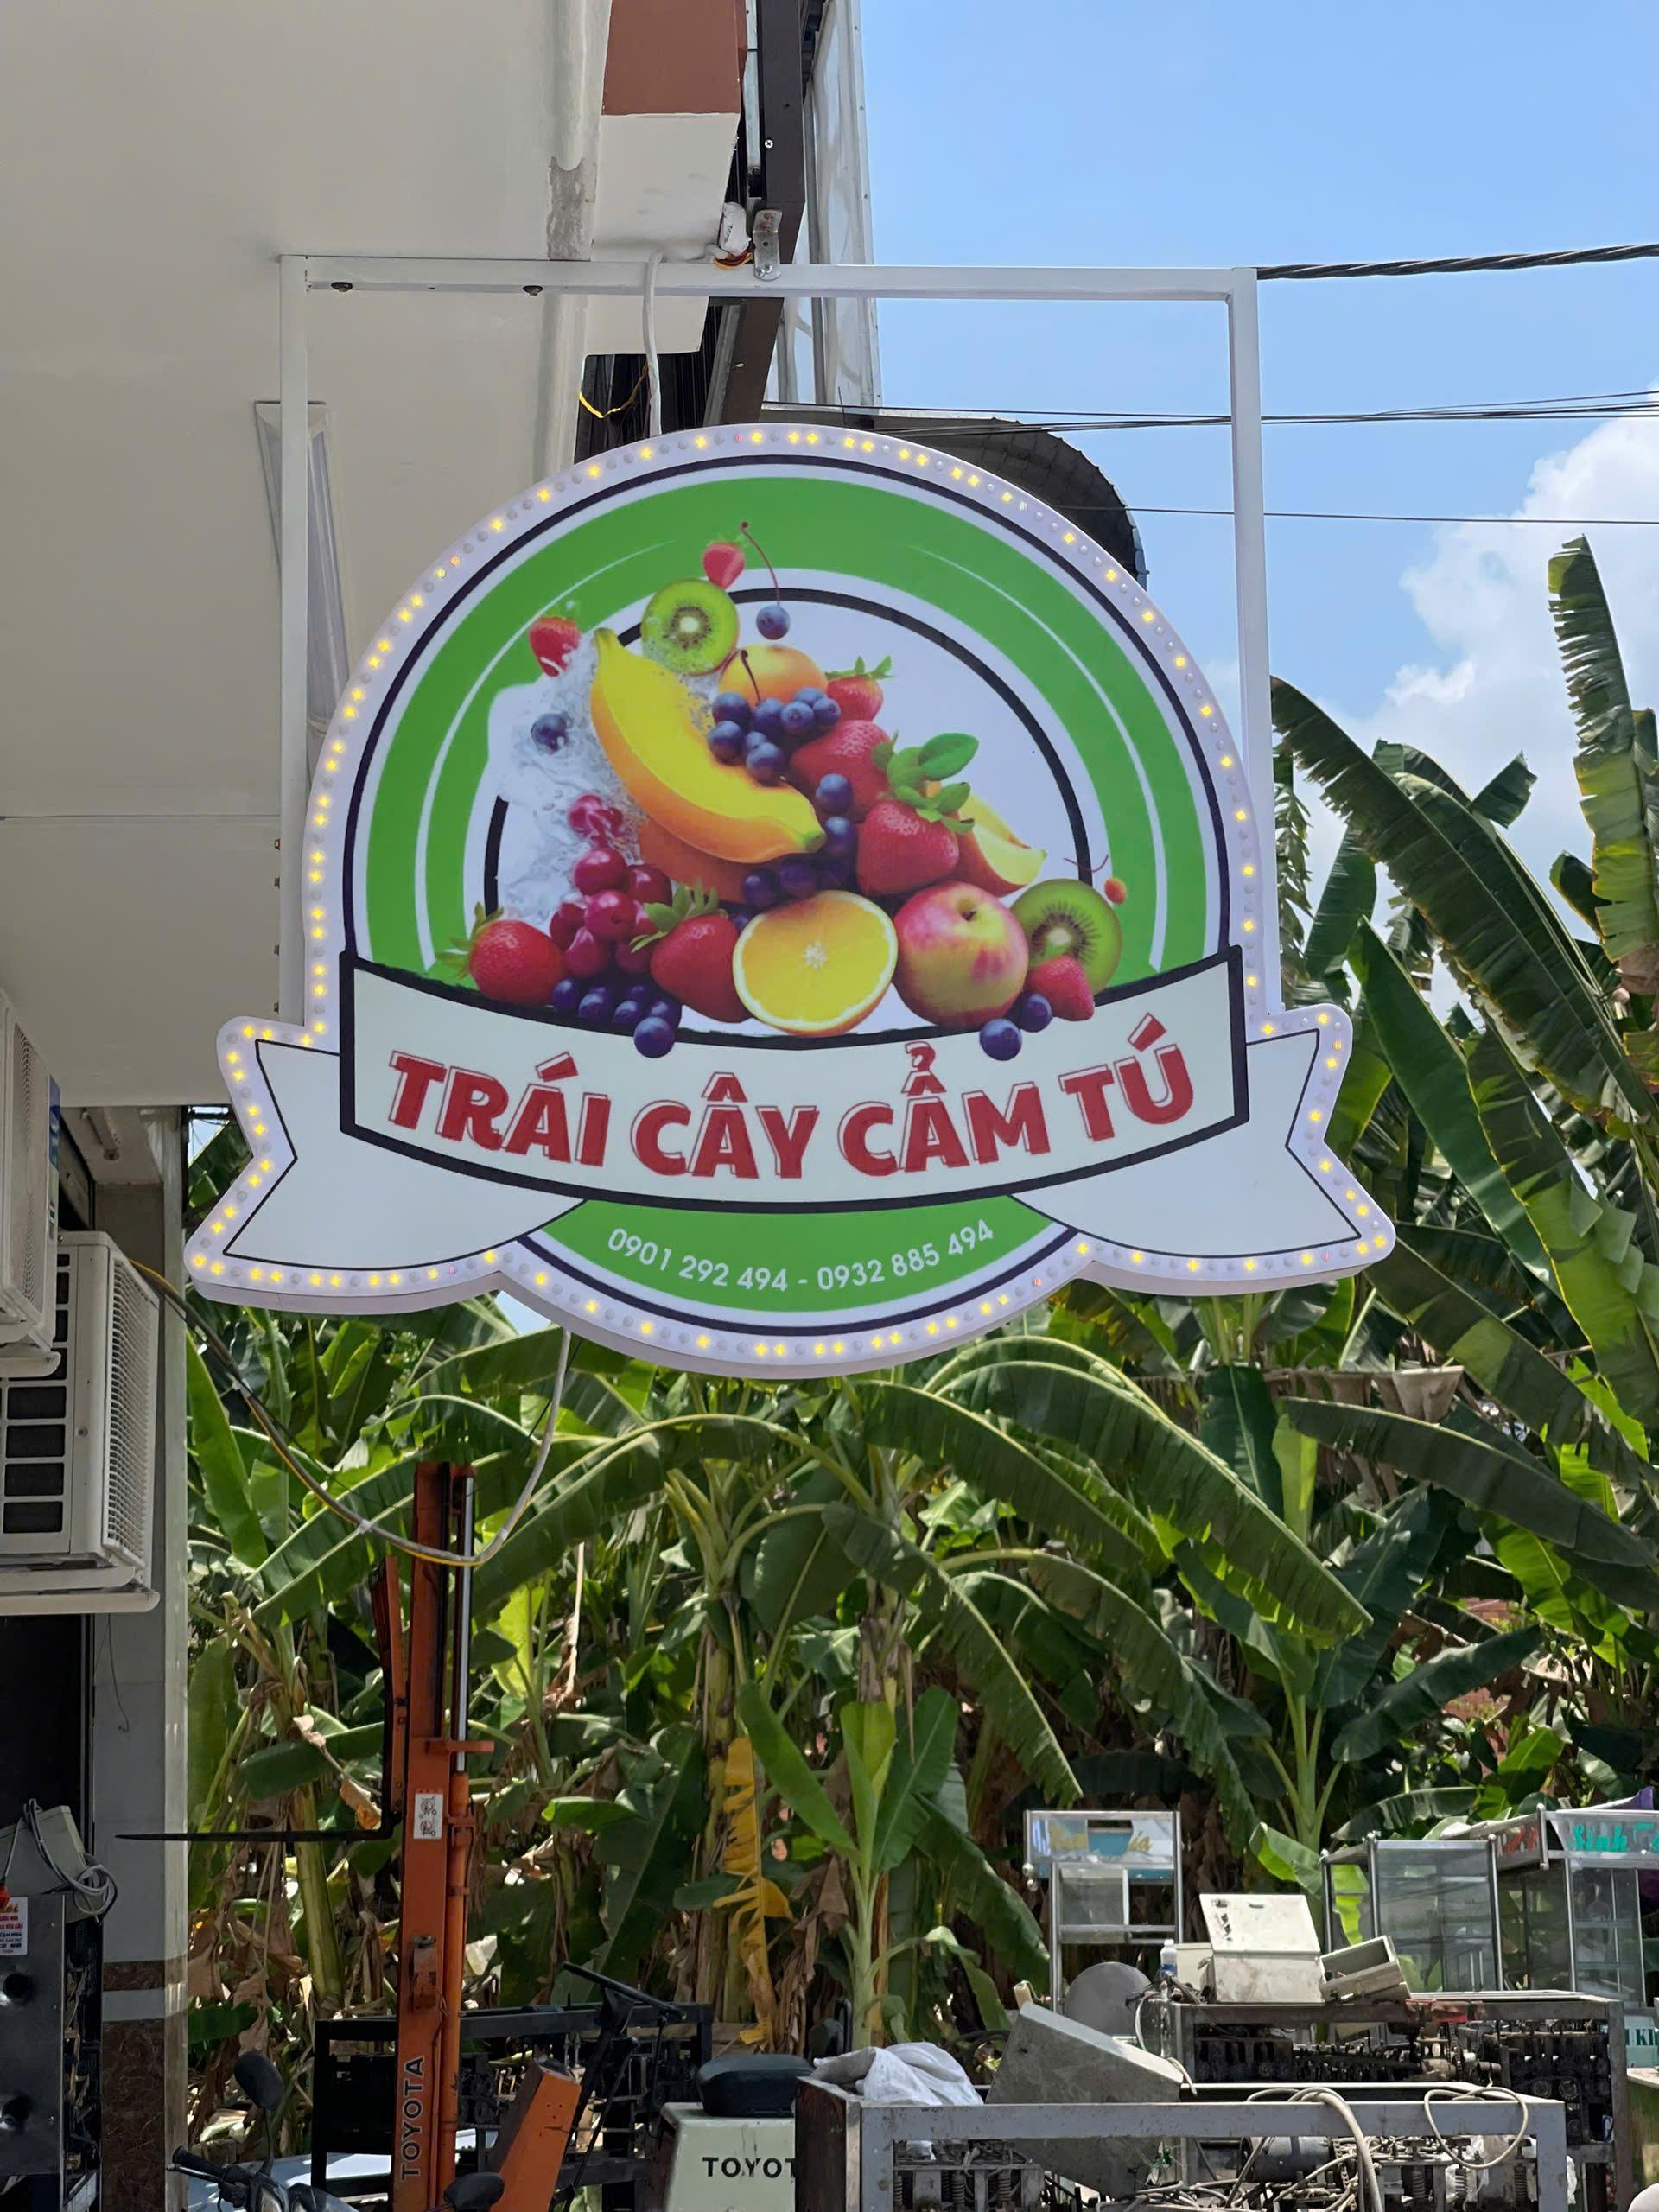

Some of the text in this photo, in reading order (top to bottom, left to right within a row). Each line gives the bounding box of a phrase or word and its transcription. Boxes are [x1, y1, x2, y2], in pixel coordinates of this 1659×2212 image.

[388, 1012, 1193, 1179] TRÁI CÂY CẨM TÚ
[608, 1228, 671, 1271] 0901
[678, 1255, 729, 1287] 292
[736, 1267, 788, 1292] 494
[817, 1259, 885, 1291] 0932
[891, 1243, 940, 1276] 885
[948, 1218, 993, 1255] 494
[401, 2055, 425, 2181] TOYOTA
